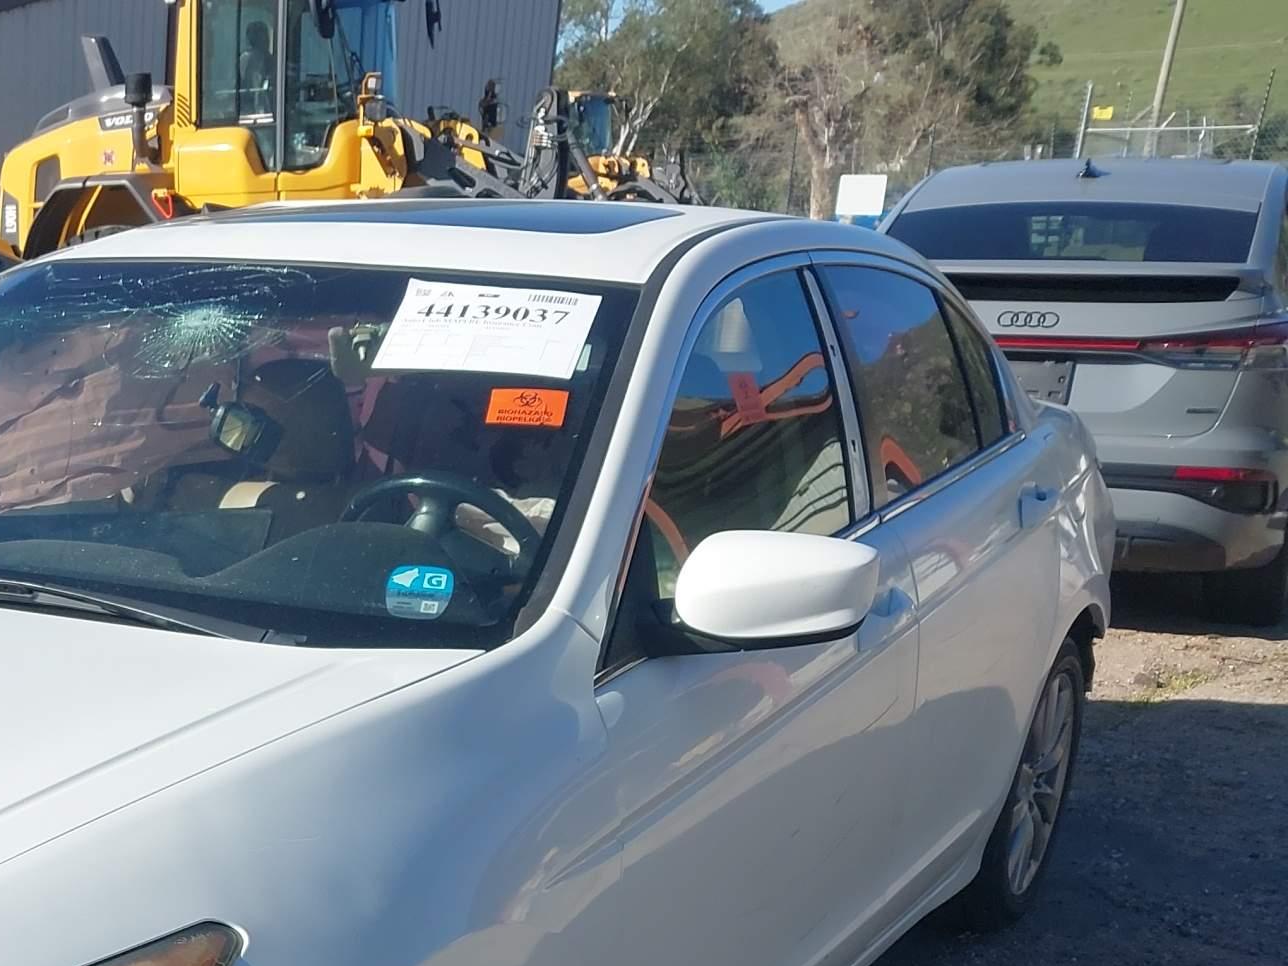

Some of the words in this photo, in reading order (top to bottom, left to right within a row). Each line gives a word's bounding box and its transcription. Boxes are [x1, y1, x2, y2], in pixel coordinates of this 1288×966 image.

[103, 111, 154, 127] VOLO
[417, 302, 572, 325] 44139037
[427, 575, 443, 587] G
